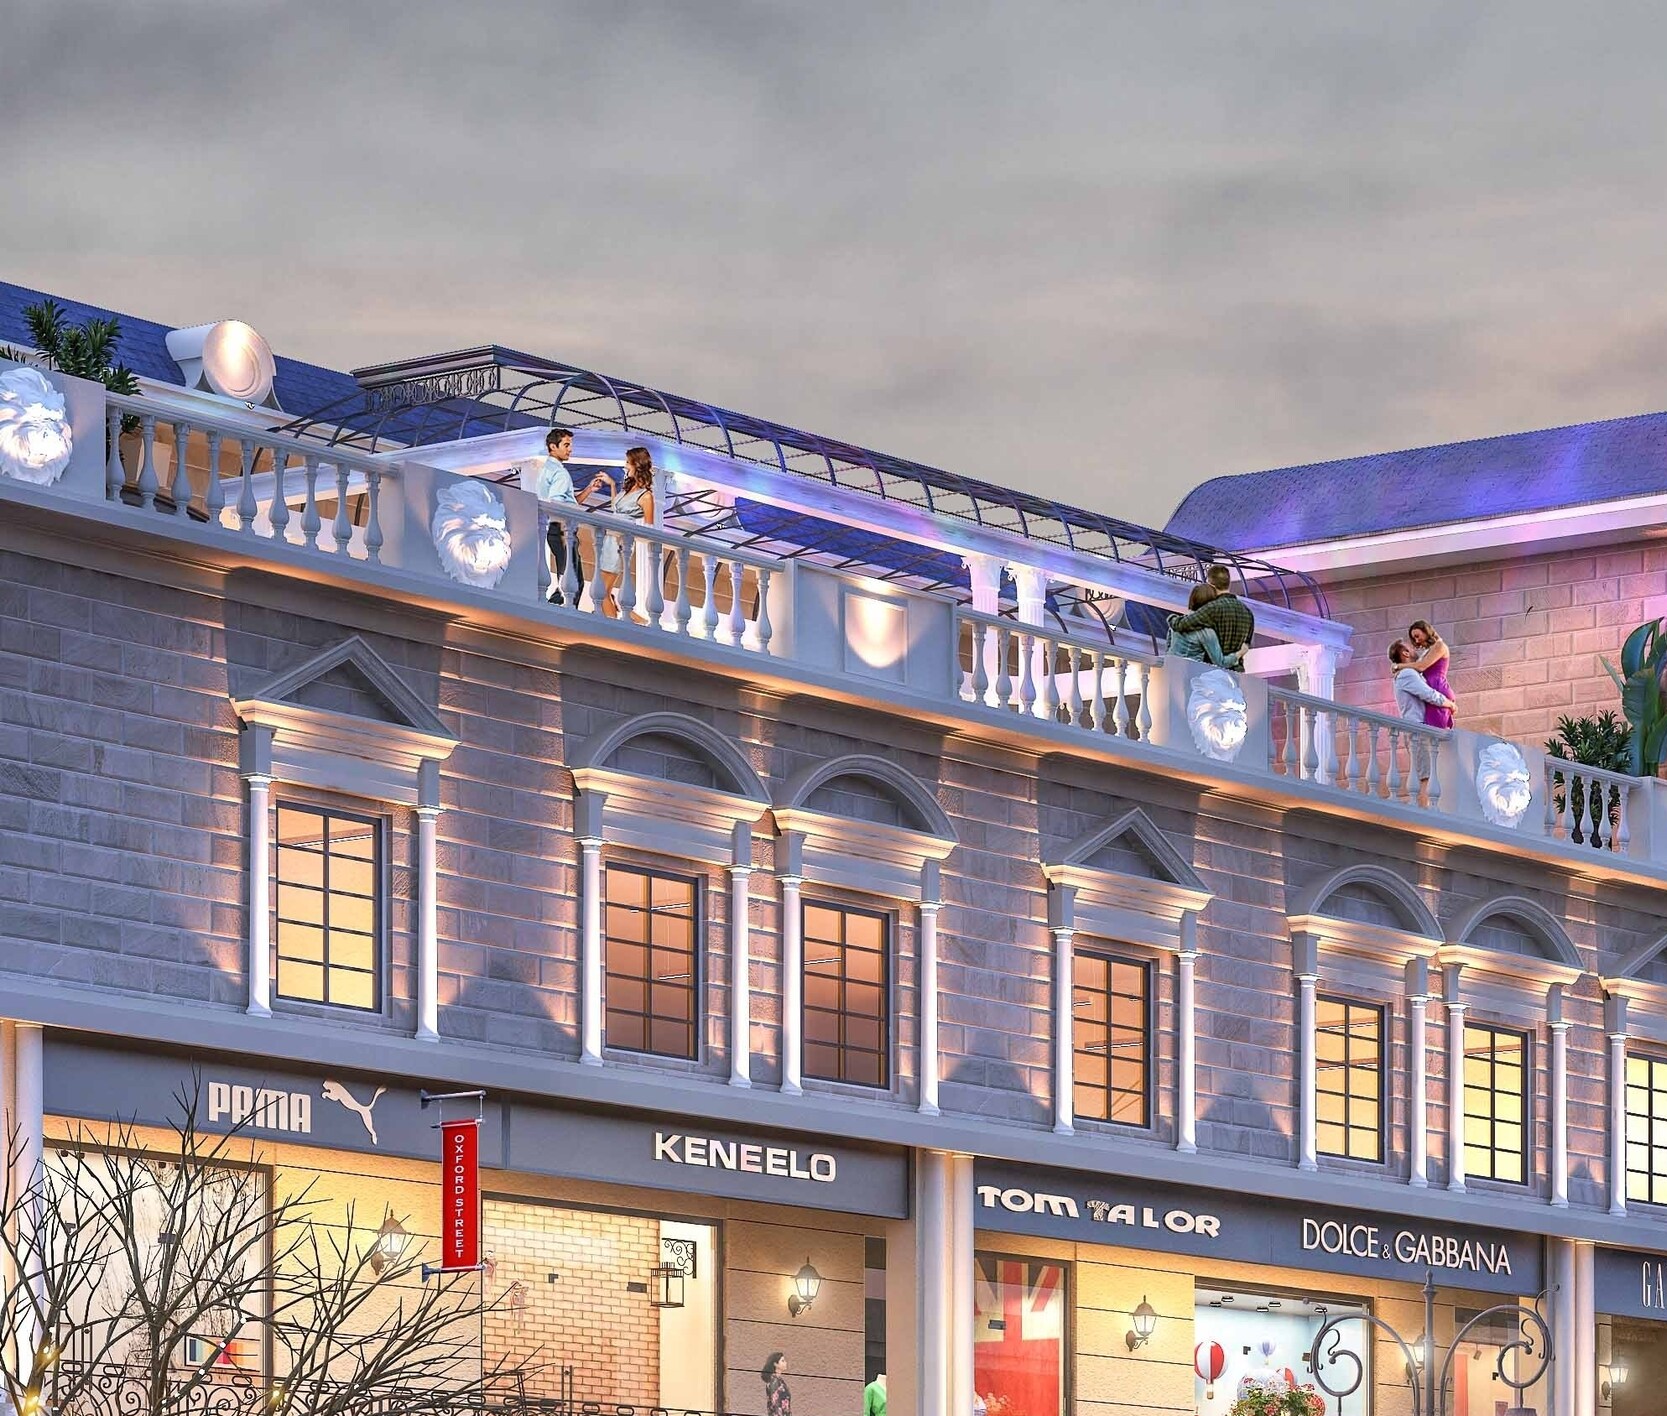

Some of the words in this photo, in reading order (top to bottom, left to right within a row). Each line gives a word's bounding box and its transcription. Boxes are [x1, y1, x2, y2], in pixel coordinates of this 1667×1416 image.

[208, 1081, 311, 1134] PAMA
[454, 1134, 465, 1194] OXFORD
[653, 1131, 837, 1183] KENEELO
[454, 1198, 465, 1258] STREET
[977, 1186, 1079, 1218] TOM
[1303, 1218, 1379, 1259] DOLCE
[1382, 1243, 1392, 1260] &
[1395, 1231, 1512, 1276] GABBANA
